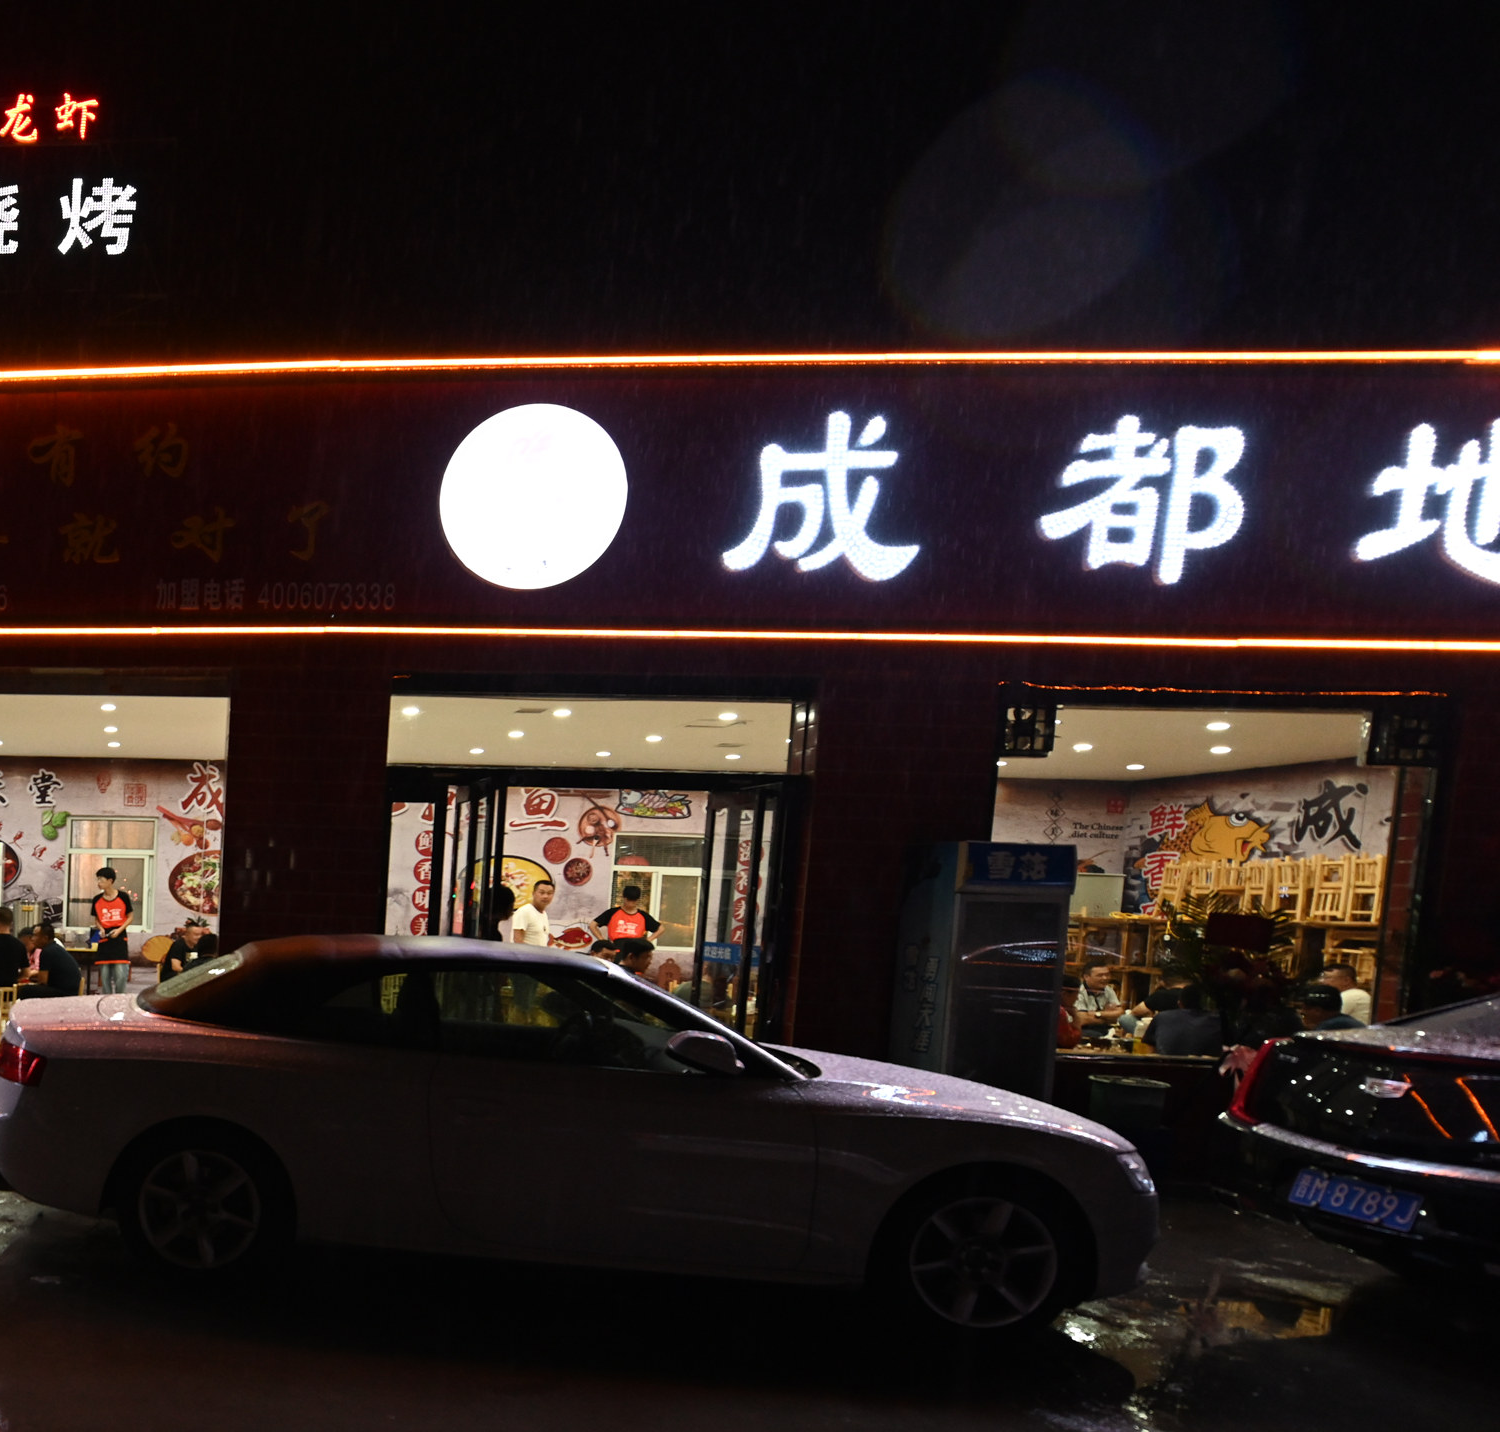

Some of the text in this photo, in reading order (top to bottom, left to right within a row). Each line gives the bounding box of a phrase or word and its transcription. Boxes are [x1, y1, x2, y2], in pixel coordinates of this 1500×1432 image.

[155, 577, 397, 612] 加盟电话 4006073338
[1071, 831, 1120, 840] diet culture
[1072, 822, 1124, 831] The Chinese
[987, 850, 1050, 882] 雪花
